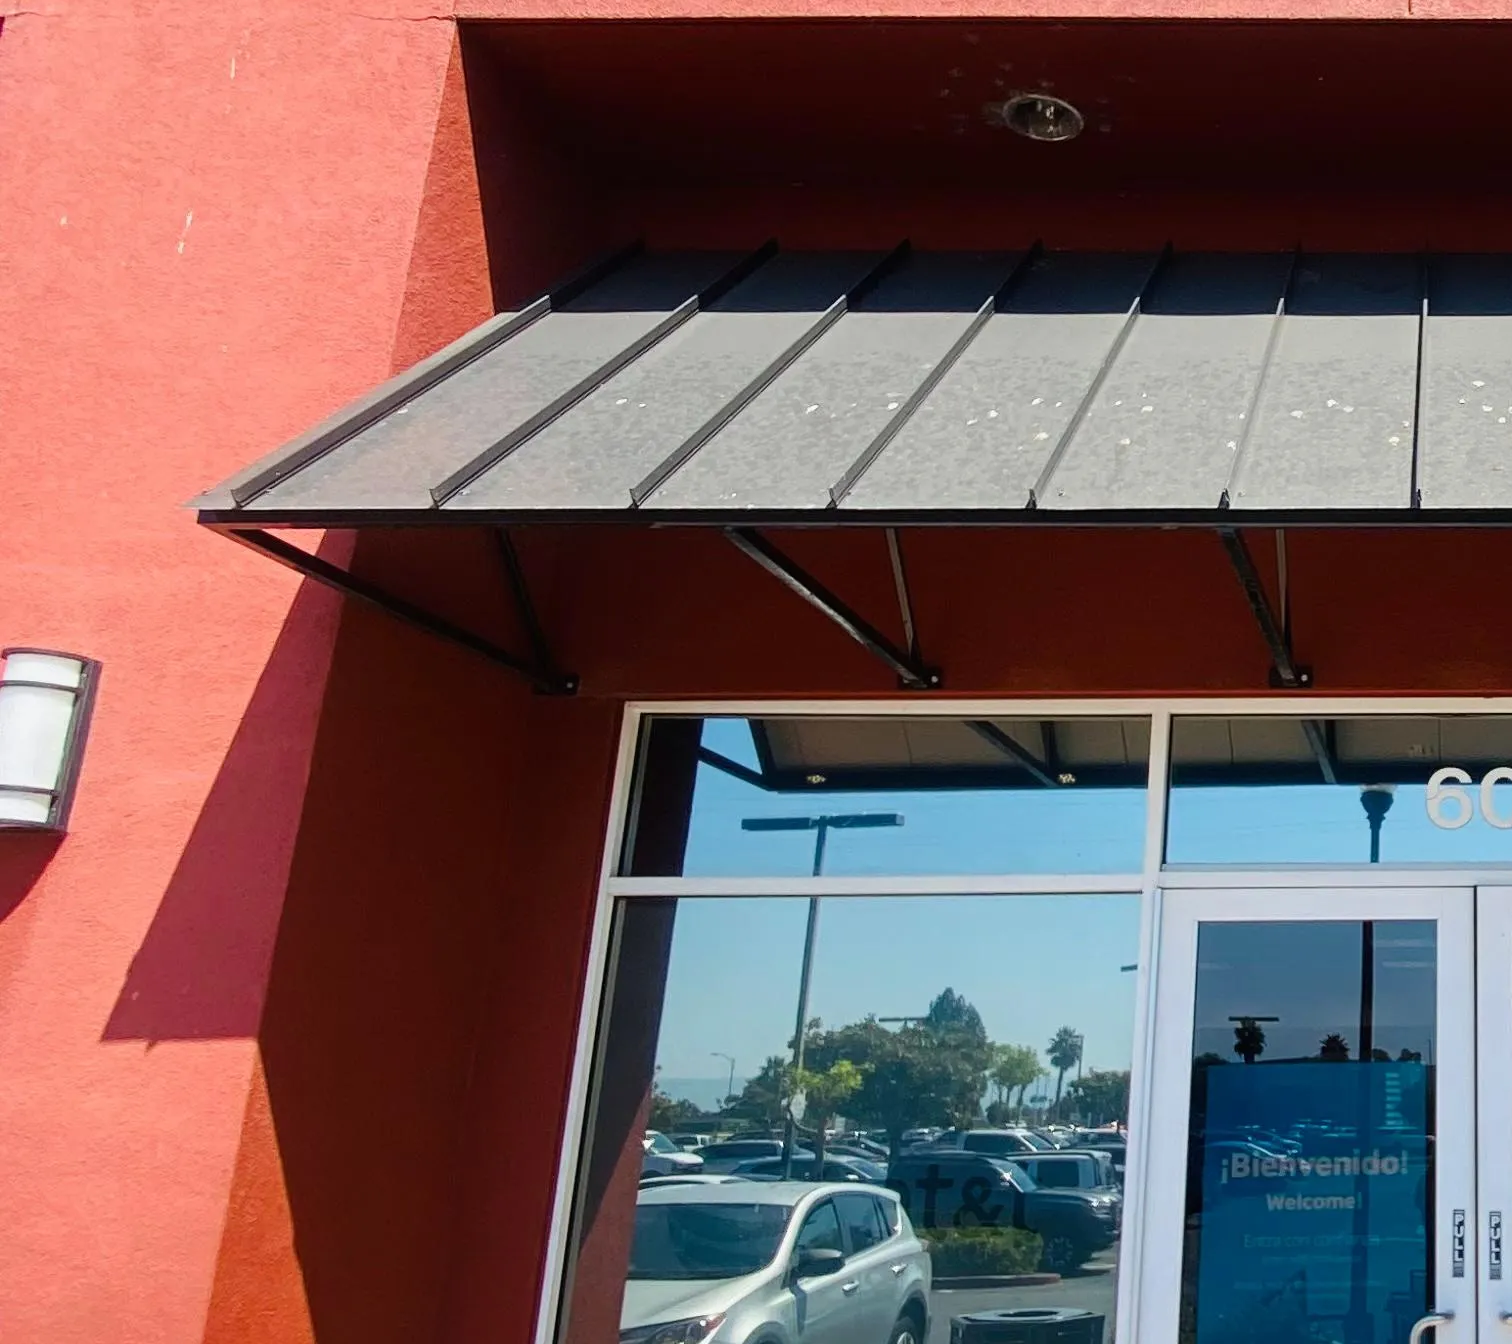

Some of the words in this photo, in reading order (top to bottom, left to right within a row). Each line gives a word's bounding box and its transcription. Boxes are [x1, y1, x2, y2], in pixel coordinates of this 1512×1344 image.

[1221, 1149, 1408, 1184] ¡Bienvenido!
[1266, 1193, 1362, 1212] Welcome!
[1454, 1214, 1464, 1262] PULL
[1490, 1216, 1501, 1264] PULL
